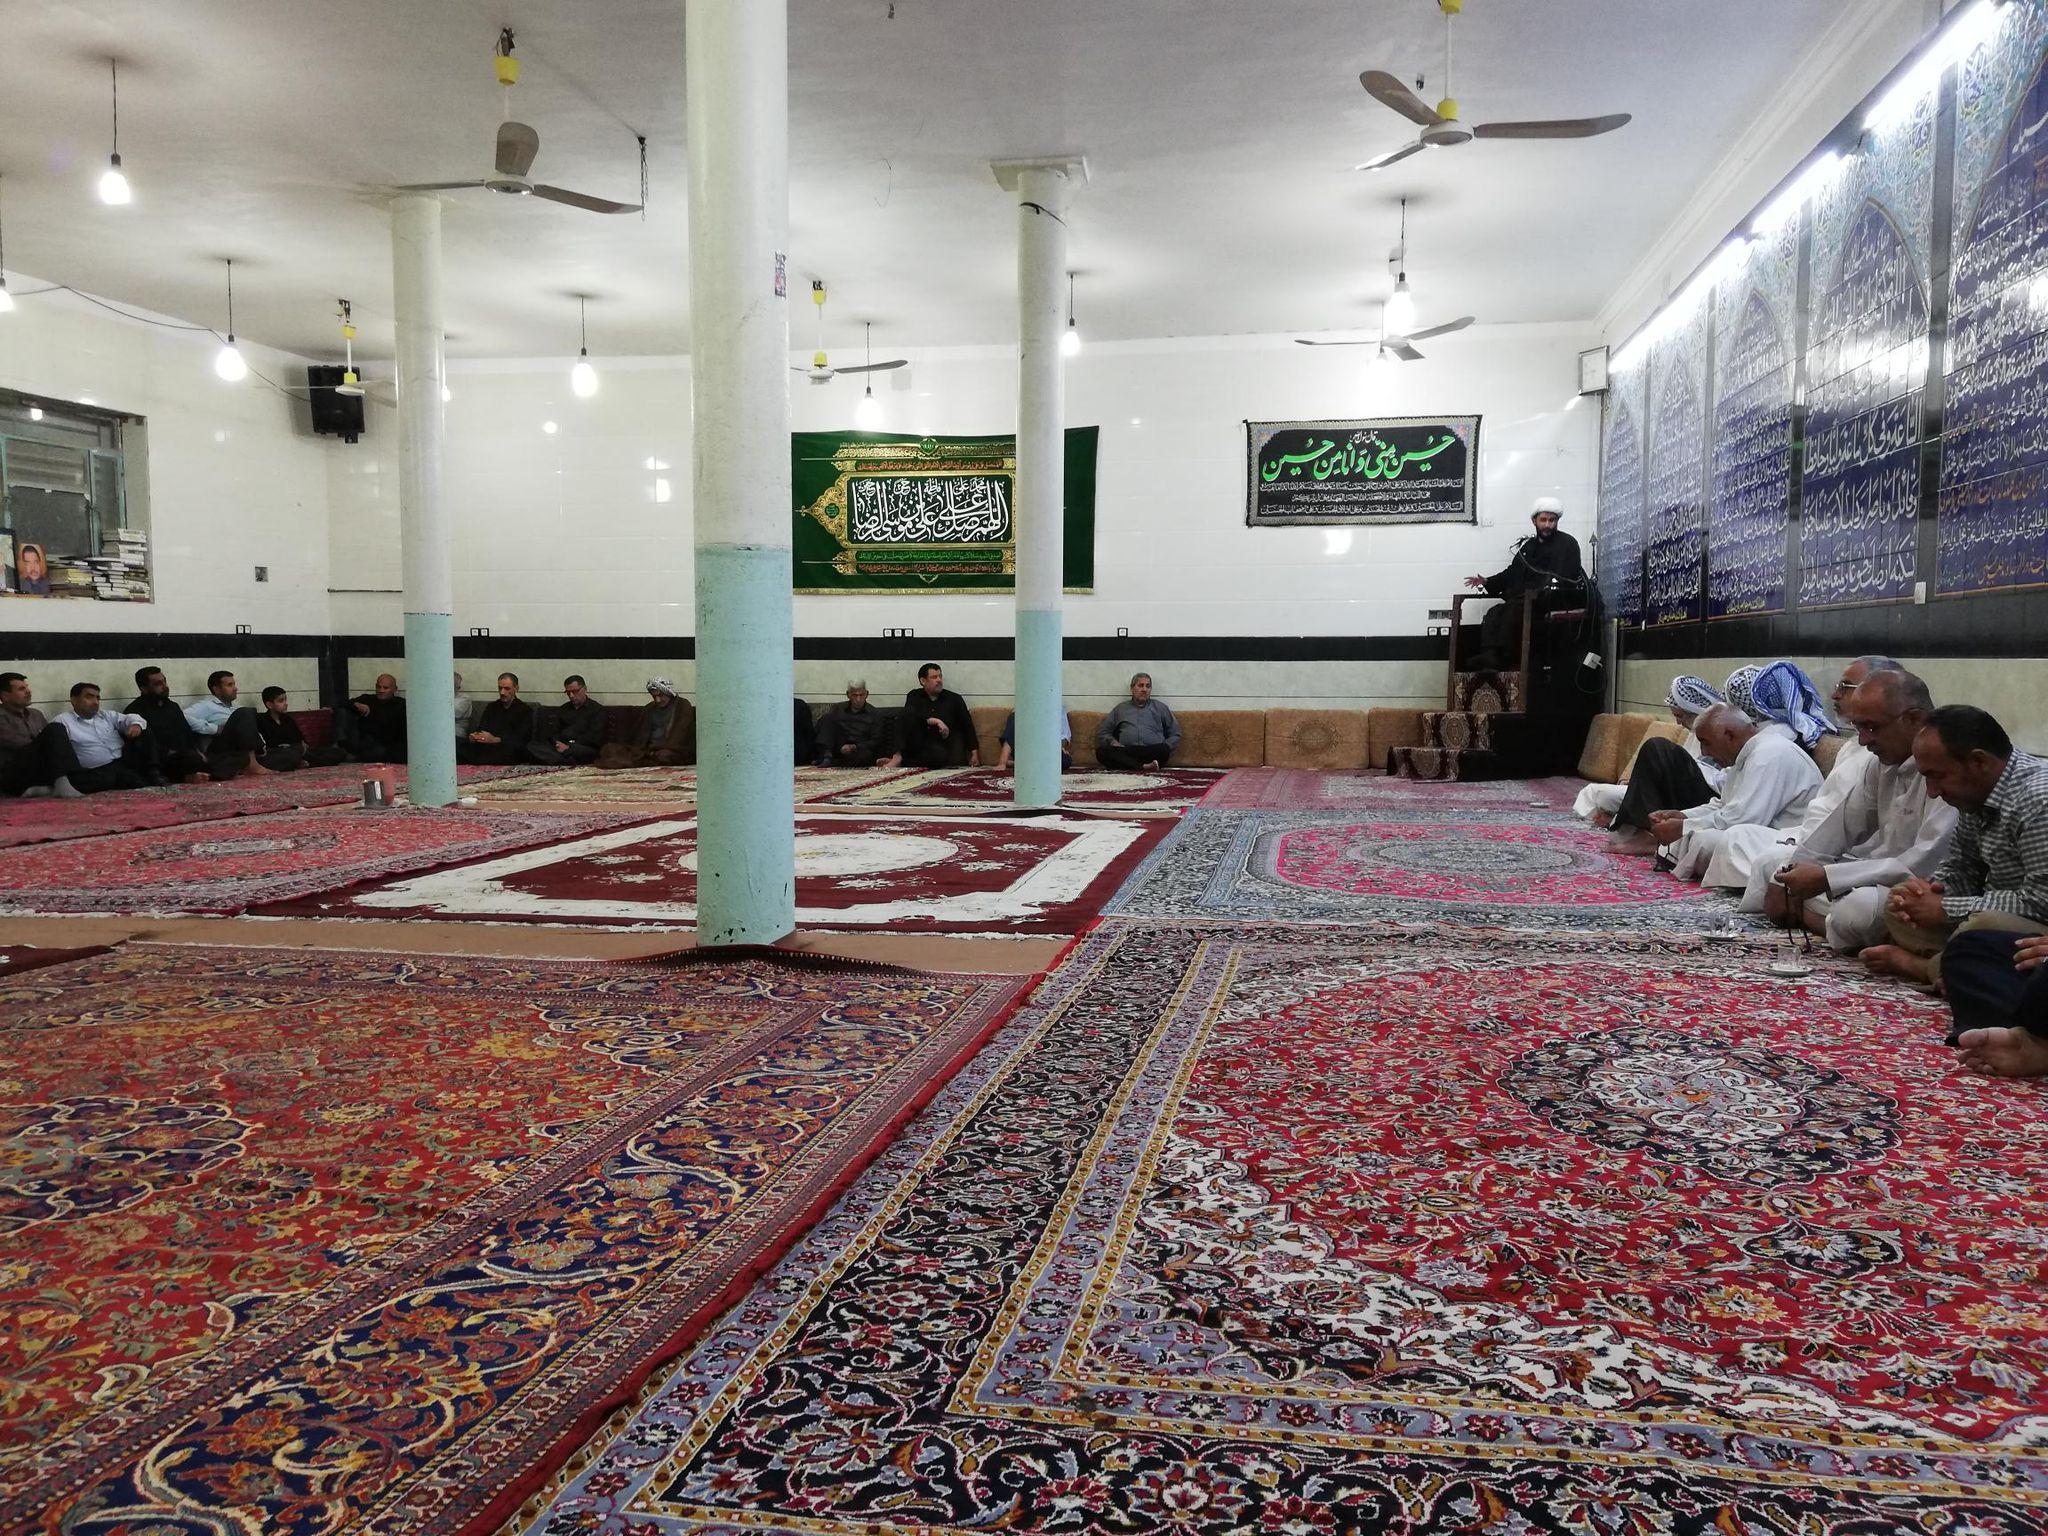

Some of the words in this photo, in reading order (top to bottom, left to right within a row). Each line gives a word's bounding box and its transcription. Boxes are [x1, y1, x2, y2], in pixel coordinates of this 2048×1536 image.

[1262, 438, 1335, 482] حسين
[1313, 450, 1343, 480] من
[1384, 435, 1456, 479] حسين
[962, 480, 1009, 541] اللهم
